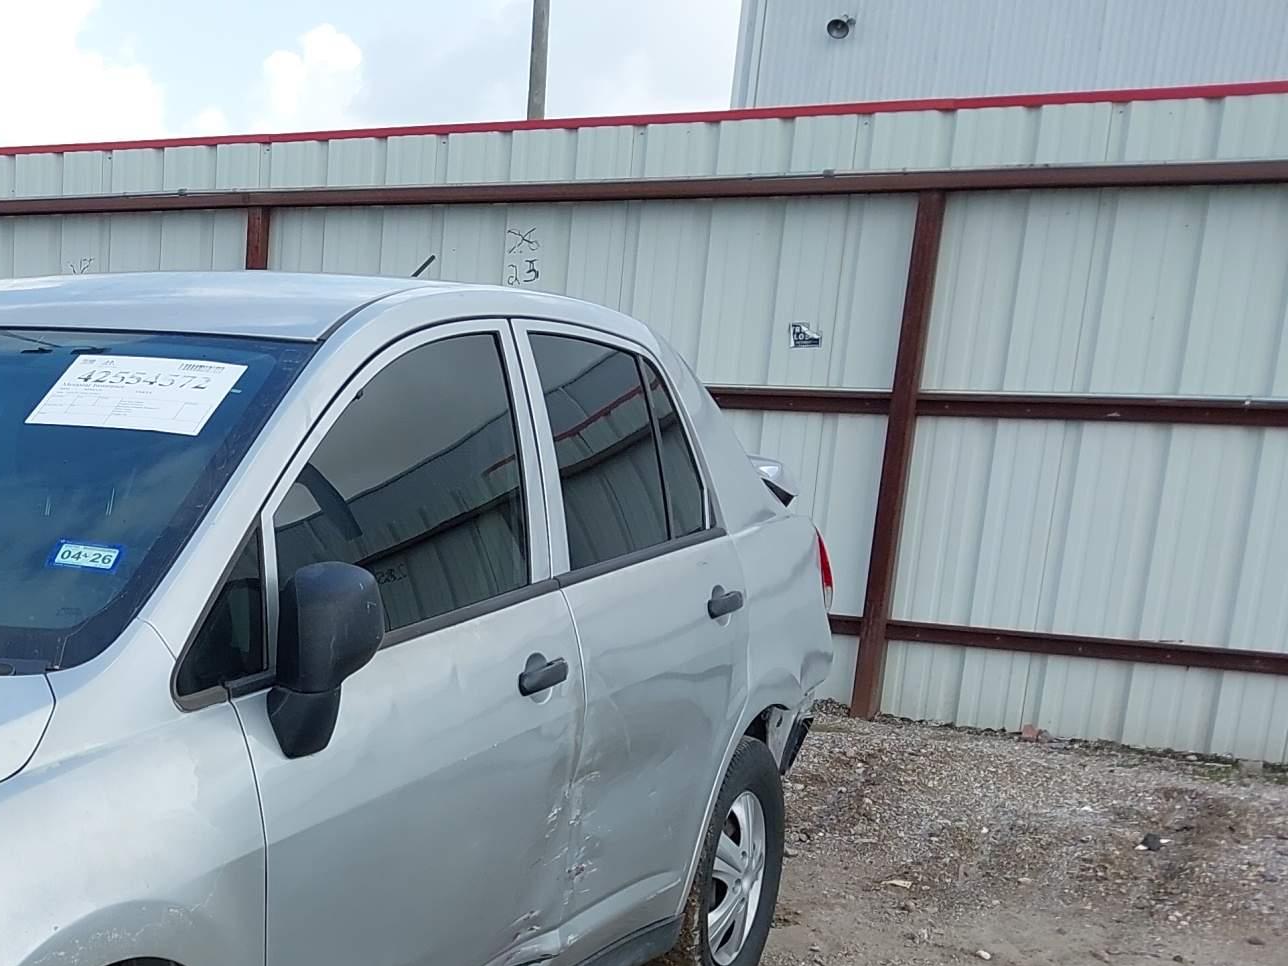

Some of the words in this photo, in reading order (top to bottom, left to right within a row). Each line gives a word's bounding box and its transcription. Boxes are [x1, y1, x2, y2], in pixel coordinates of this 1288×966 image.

[76, 369, 212, 390] 42554572
[60, 549, 82, 561] 04
[89, 552, 113, 565] 26
